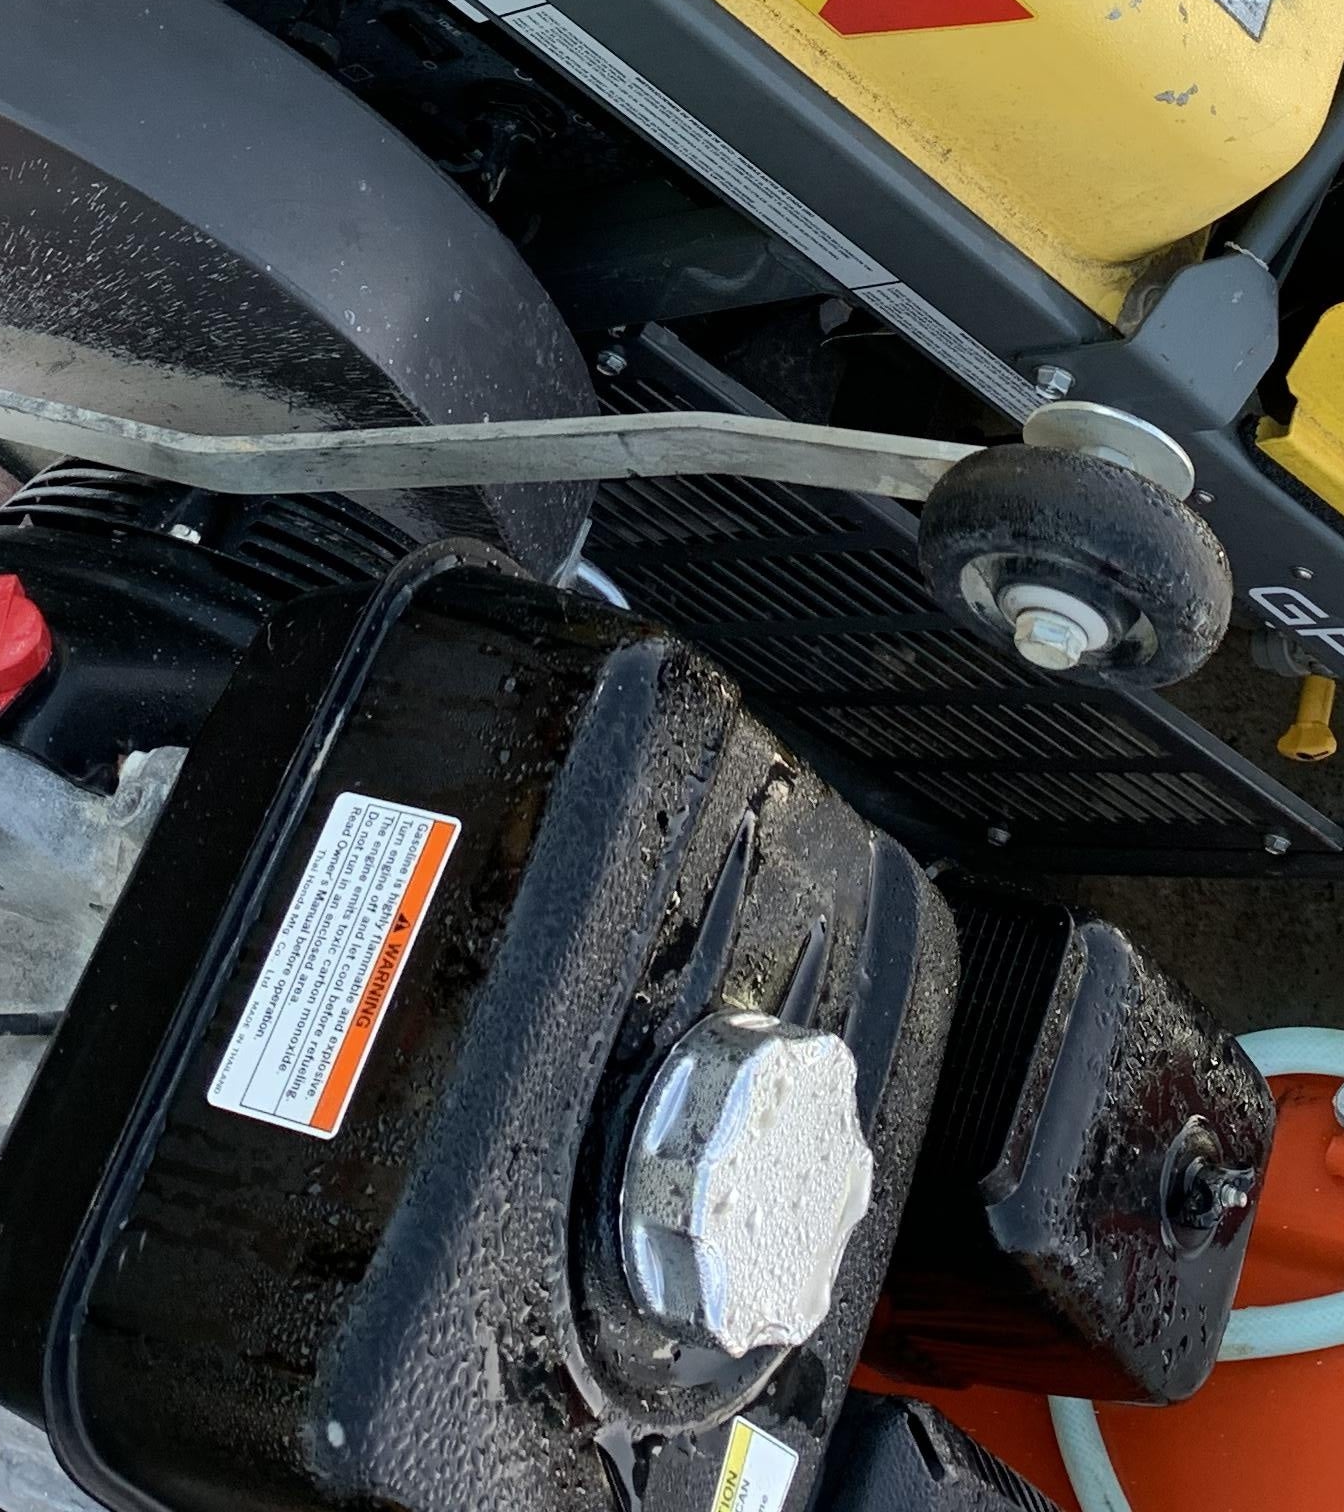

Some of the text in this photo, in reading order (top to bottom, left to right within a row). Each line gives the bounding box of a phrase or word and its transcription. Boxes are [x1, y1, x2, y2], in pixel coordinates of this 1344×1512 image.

[249, 806, 362, 1042] Read Owner's Manual before operation.
[275, 814, 395, 1076] The engine emits toxic carbon monoxide.
[282, 818, 413, 1103] Turn engine off and let cool before refueling.
[286, 810, 379, 1006] Do not run in an enclosed area.
[292, 874, 315, 910] Honda
[301, 822, 429, 1102] Gasoline is highly flammable and explosive.
[353, 941, 401, 1030] WARNING
[211, 1047, 239, 1095] THAILAND
[234, 1033, 245, 1044] IN
